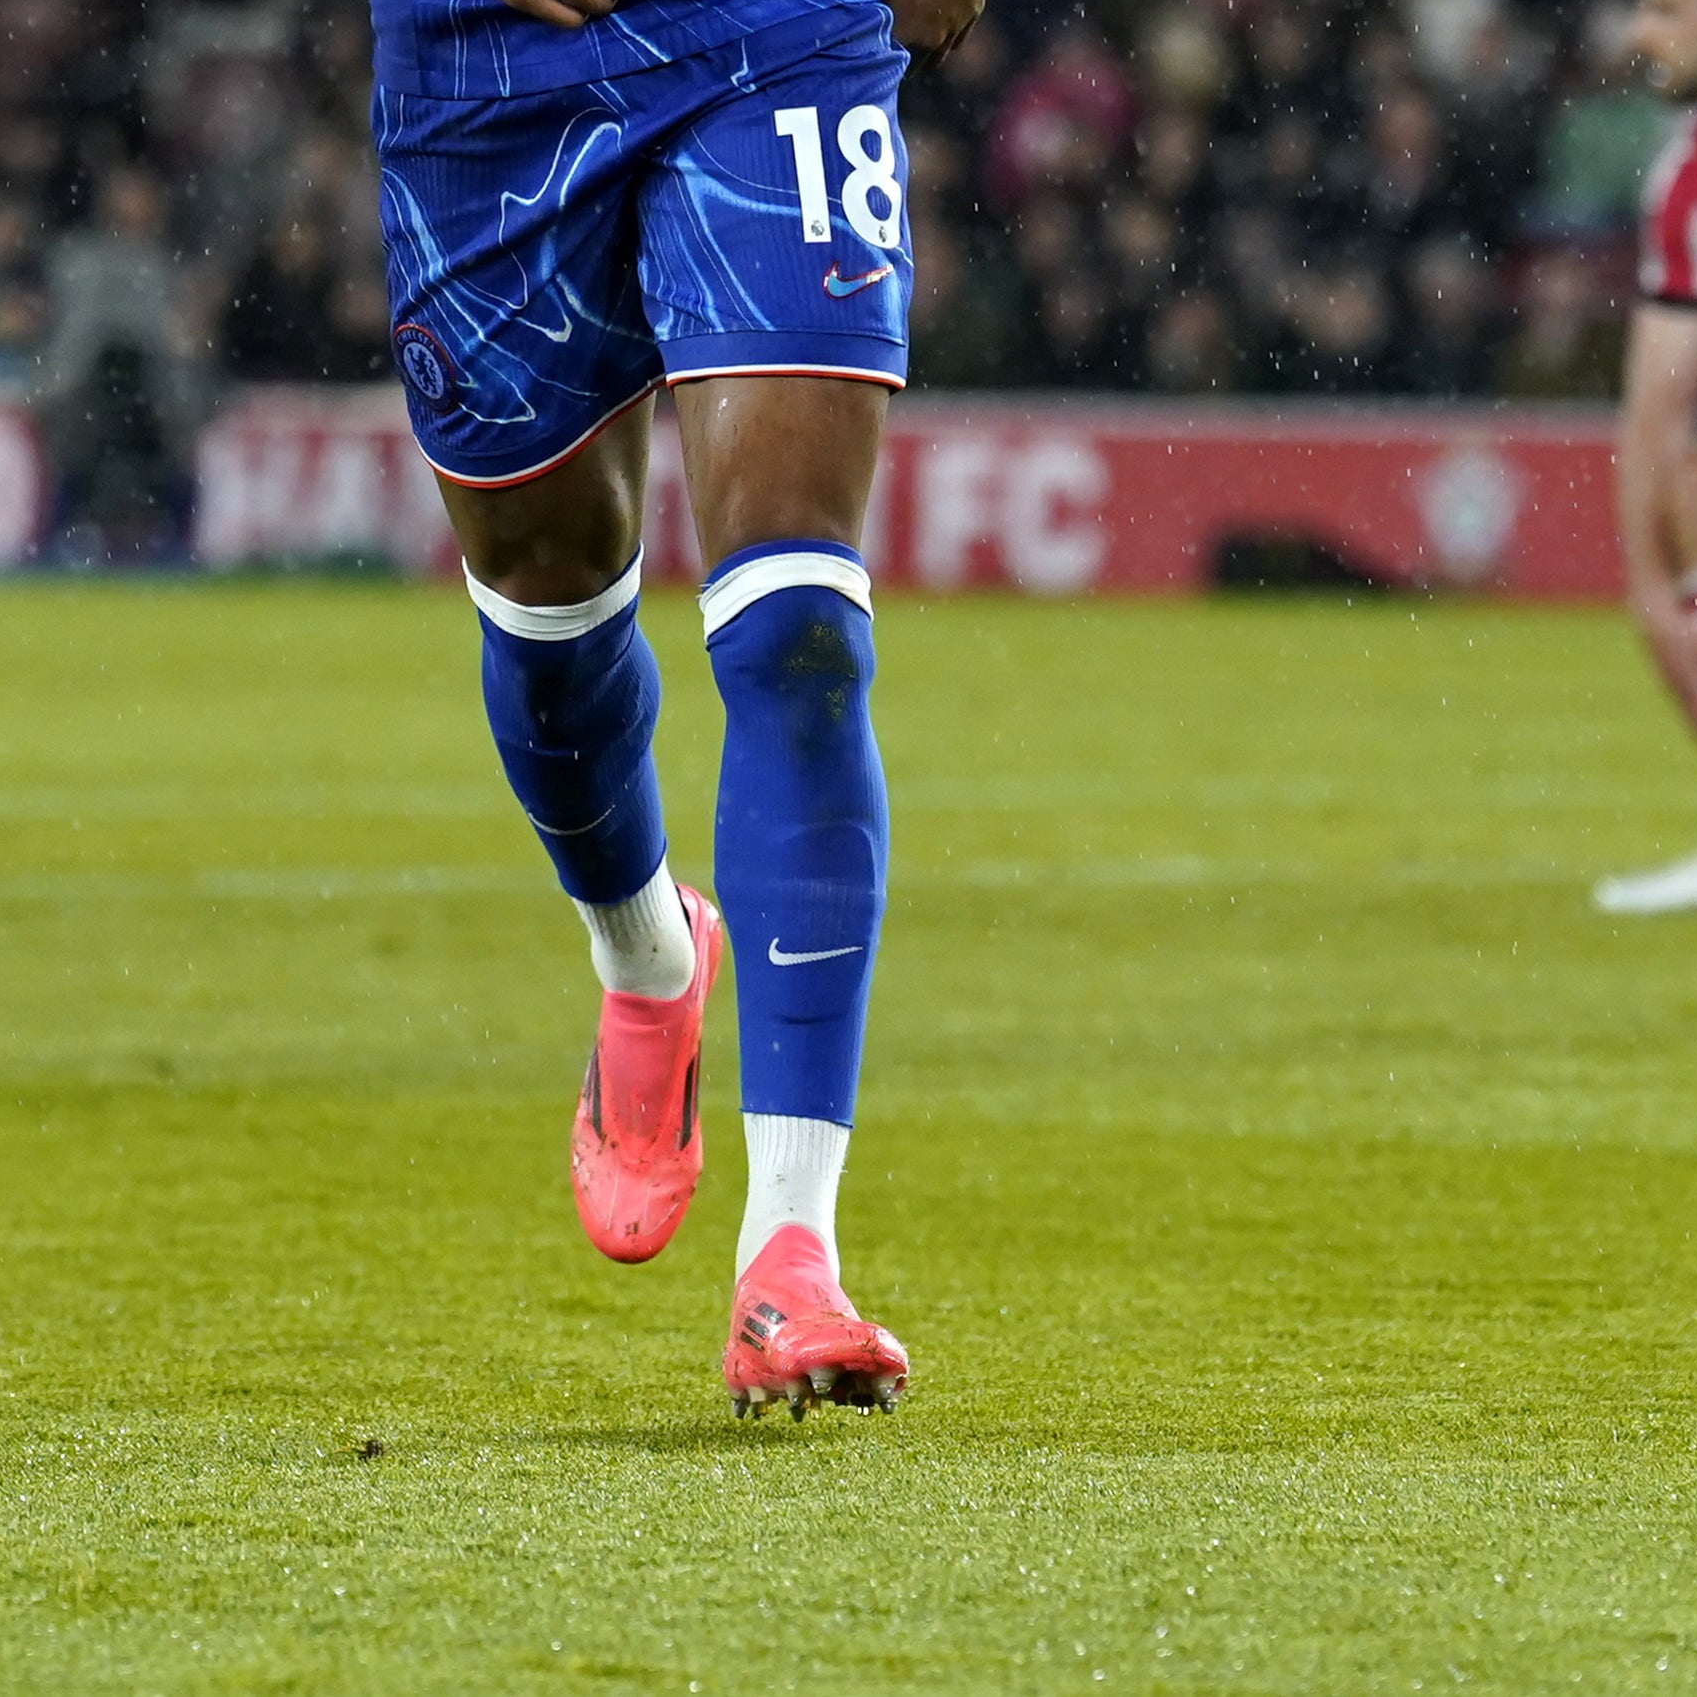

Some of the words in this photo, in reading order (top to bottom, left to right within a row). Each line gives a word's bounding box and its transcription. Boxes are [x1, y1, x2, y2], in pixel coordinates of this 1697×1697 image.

[774, 105, 901, 249] 18
[397, 330, 435, 352] CHELSEA
[917, 437, 1105, 592] FC
